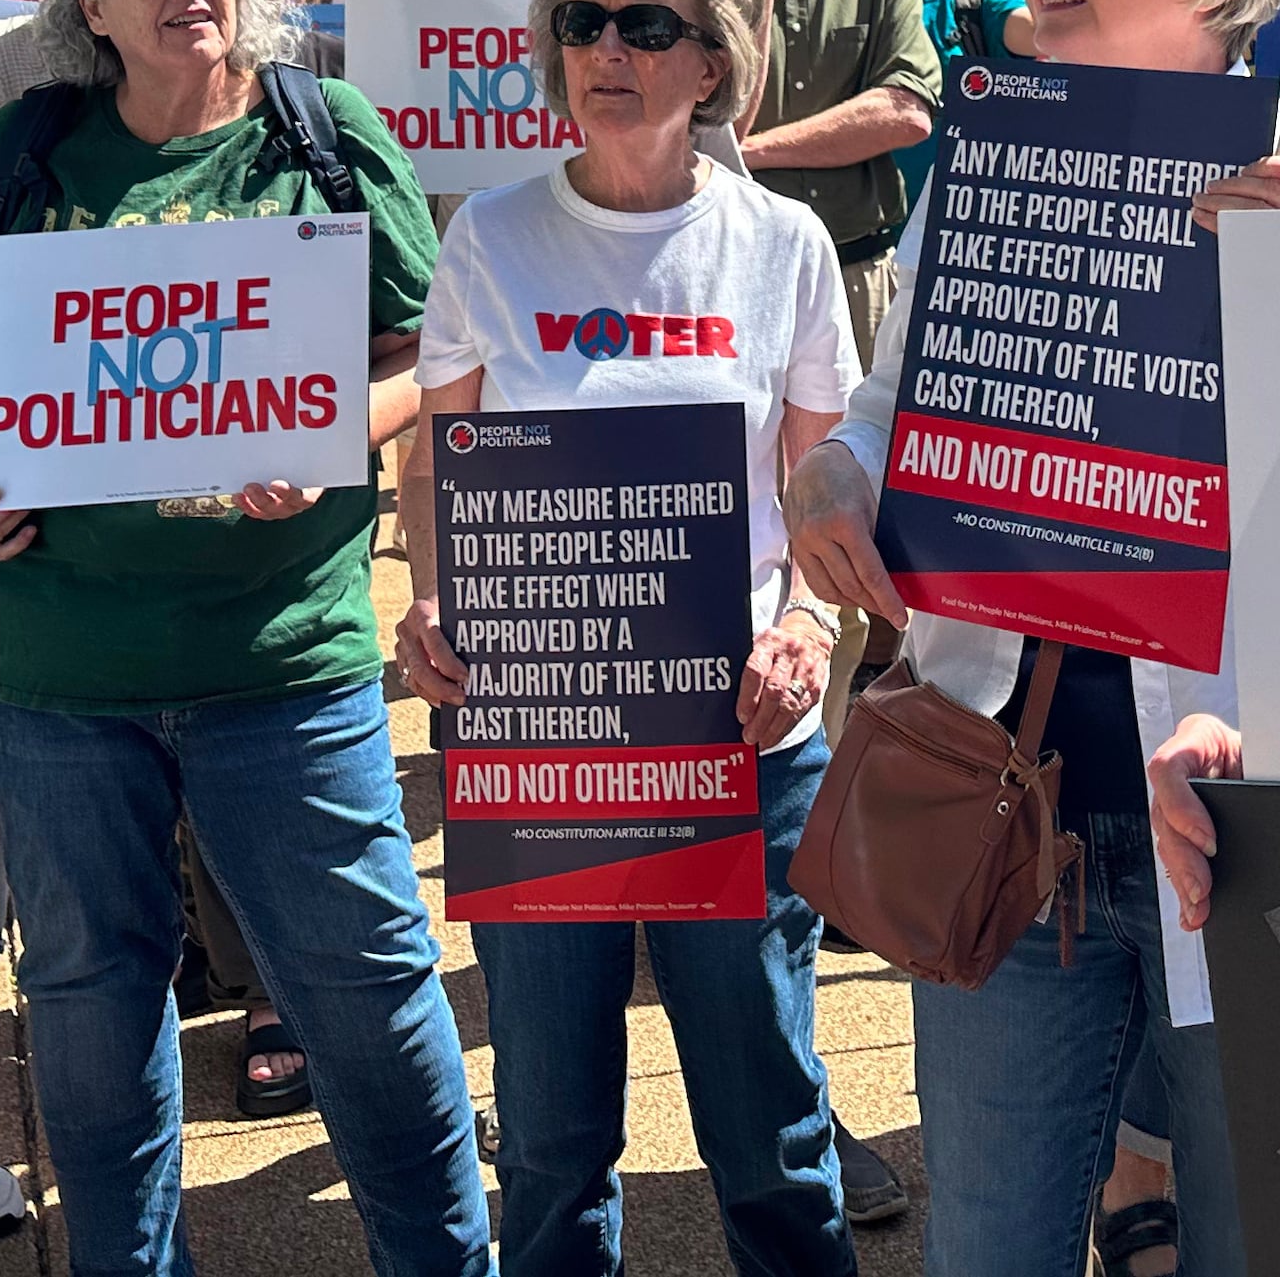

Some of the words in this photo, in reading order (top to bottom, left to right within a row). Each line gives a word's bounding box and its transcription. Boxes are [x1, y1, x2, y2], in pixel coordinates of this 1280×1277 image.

[420, 27, 534, 69] PEOP
[993, 85, 1068, 102] POLITICIANS
[996, 74, 1039, 89] PEOPLE
[1041, 77, 1068, 90] NOT
[1004, 144, 1123, 191] MEASURE
[945, 184, 973, 221] TO
[978, 187, 1021, 227] THE
[1025, 193, 1114, 238] PEOPLE
[1120, 203, 1197, 248] SHALL
[999, 237, 1085, 282] EFFECT
[1088, 248, 1163, 293] WHEN
[54, 277, 270, 343] PEOPLE
[928, 276, 1060, 328] APPROVED
[1064, 294, 1100, 333] BY
[87, 316, 238, 406] NOT
[922, 322, 1052, 376] MAJORITY
[1143, 354, 1219, 403] VOTES
[914, 369, 979, 413] CAST
[981, 379, 1099, 441] THEREON,
[480, 425, 523, 437] PEOPLE
[525, 425, 550, 435] NOT
[480, 436, 551, 447] POLITICIANS
[899, 430, 963, 481] AND
[967, 441, 1027, 492] NOT
[502, 487, 614, 523] MEASURE
[620, 481, 734, 519] REFERRED
[451, 533, 478, 567] TO
[483, 533, 524, 566] THE
[530, 531, 614, 565] PEOPLE
[619, 528, 691, 563] SHALL
[978, 516, 1065, 544] CONSTITUTION
[1063, 533, 1112, 553] ARTICLE
[452, 576, 508, 610] TAKE
[513, 575, 591, 609] EFFECT
[595, 572, 666, 607] WHEN
[455, 618, 576, 653] APPROVED
[582, 618, 613, 651] BY
[618, 617, 633, 650] A
[580, 662, 608, 695] OF
[612, 661, 655, 694] THE
[659, 657, 731, 693] VOTES
[457, 706, 514, 741] CAST
[516, 706, 630, 744] THEREON,
[455, 764, 511, 804] AND
[518, 764, 569, 803] NOT
[535, 828, 614, 839] CONSTITUTION
[614, 827, 655, 838] ARTICLE
